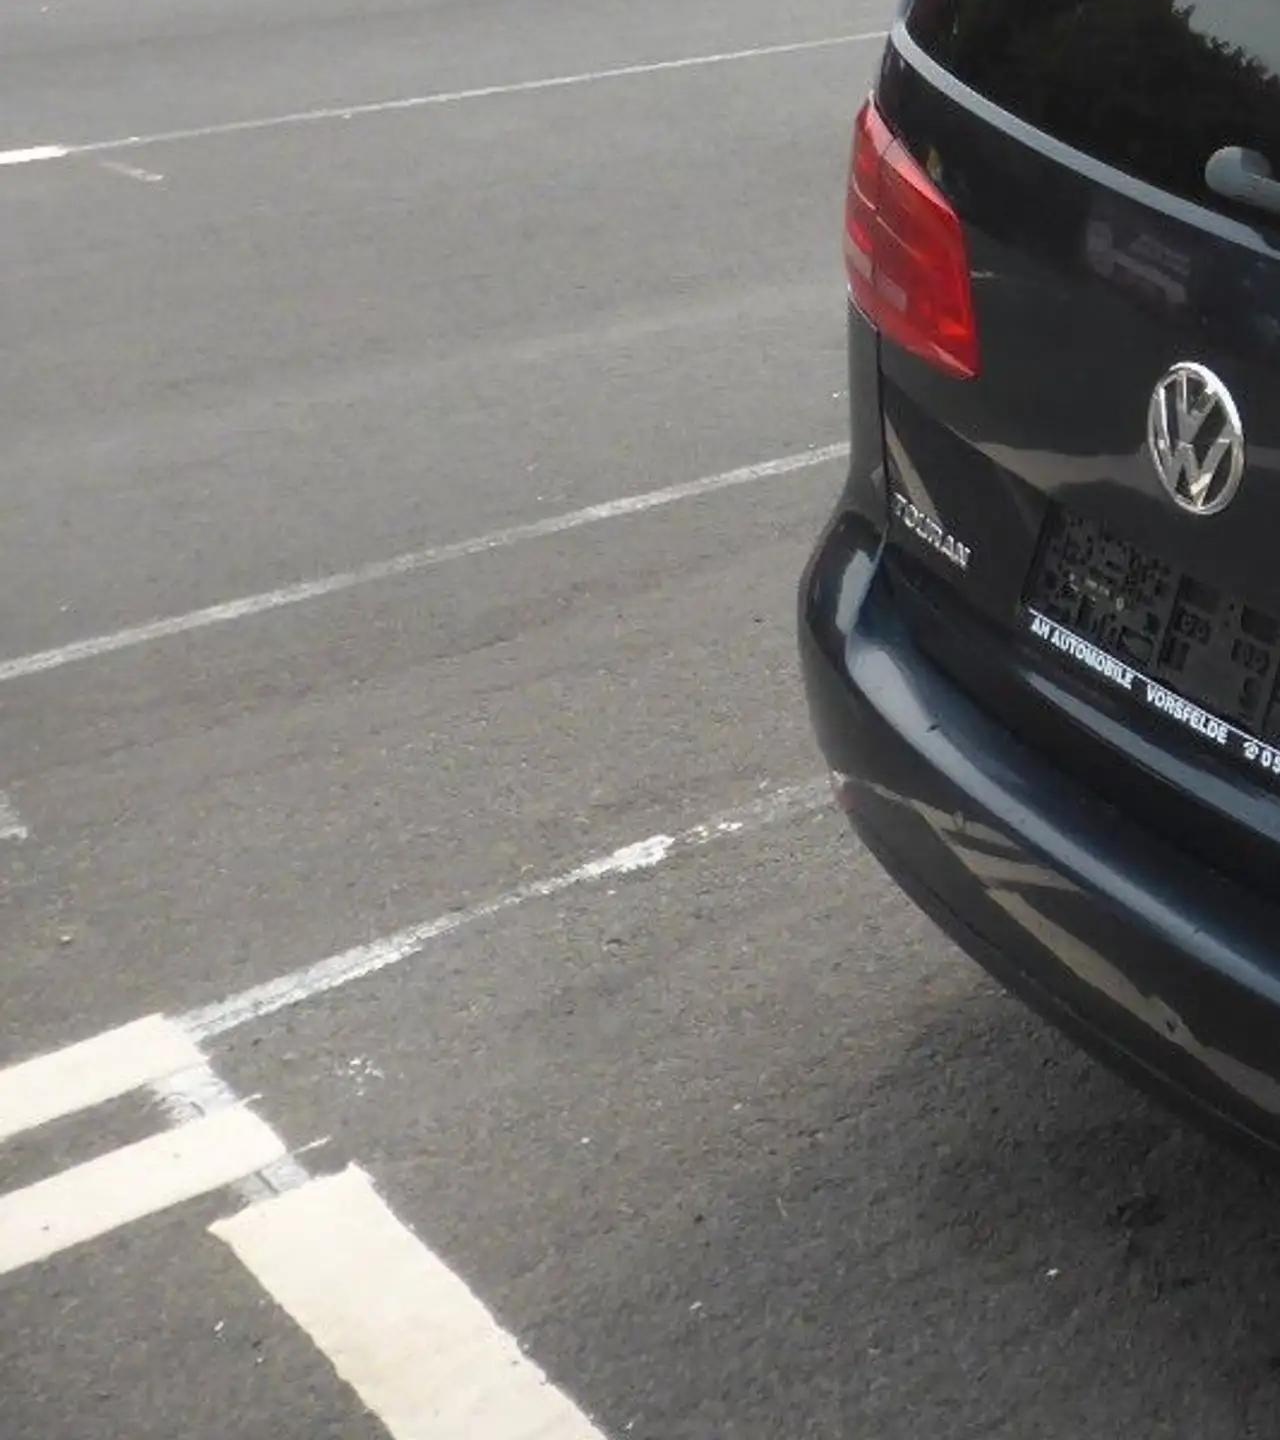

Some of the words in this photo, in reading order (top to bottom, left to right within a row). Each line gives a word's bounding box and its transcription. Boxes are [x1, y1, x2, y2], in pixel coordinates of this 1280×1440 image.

[893, 491, 971, 571] TOURAN
[1051, 629, 1135, 690] AUTOMOBILE
[1146, 682, 1229, 745] VORSFELDE
